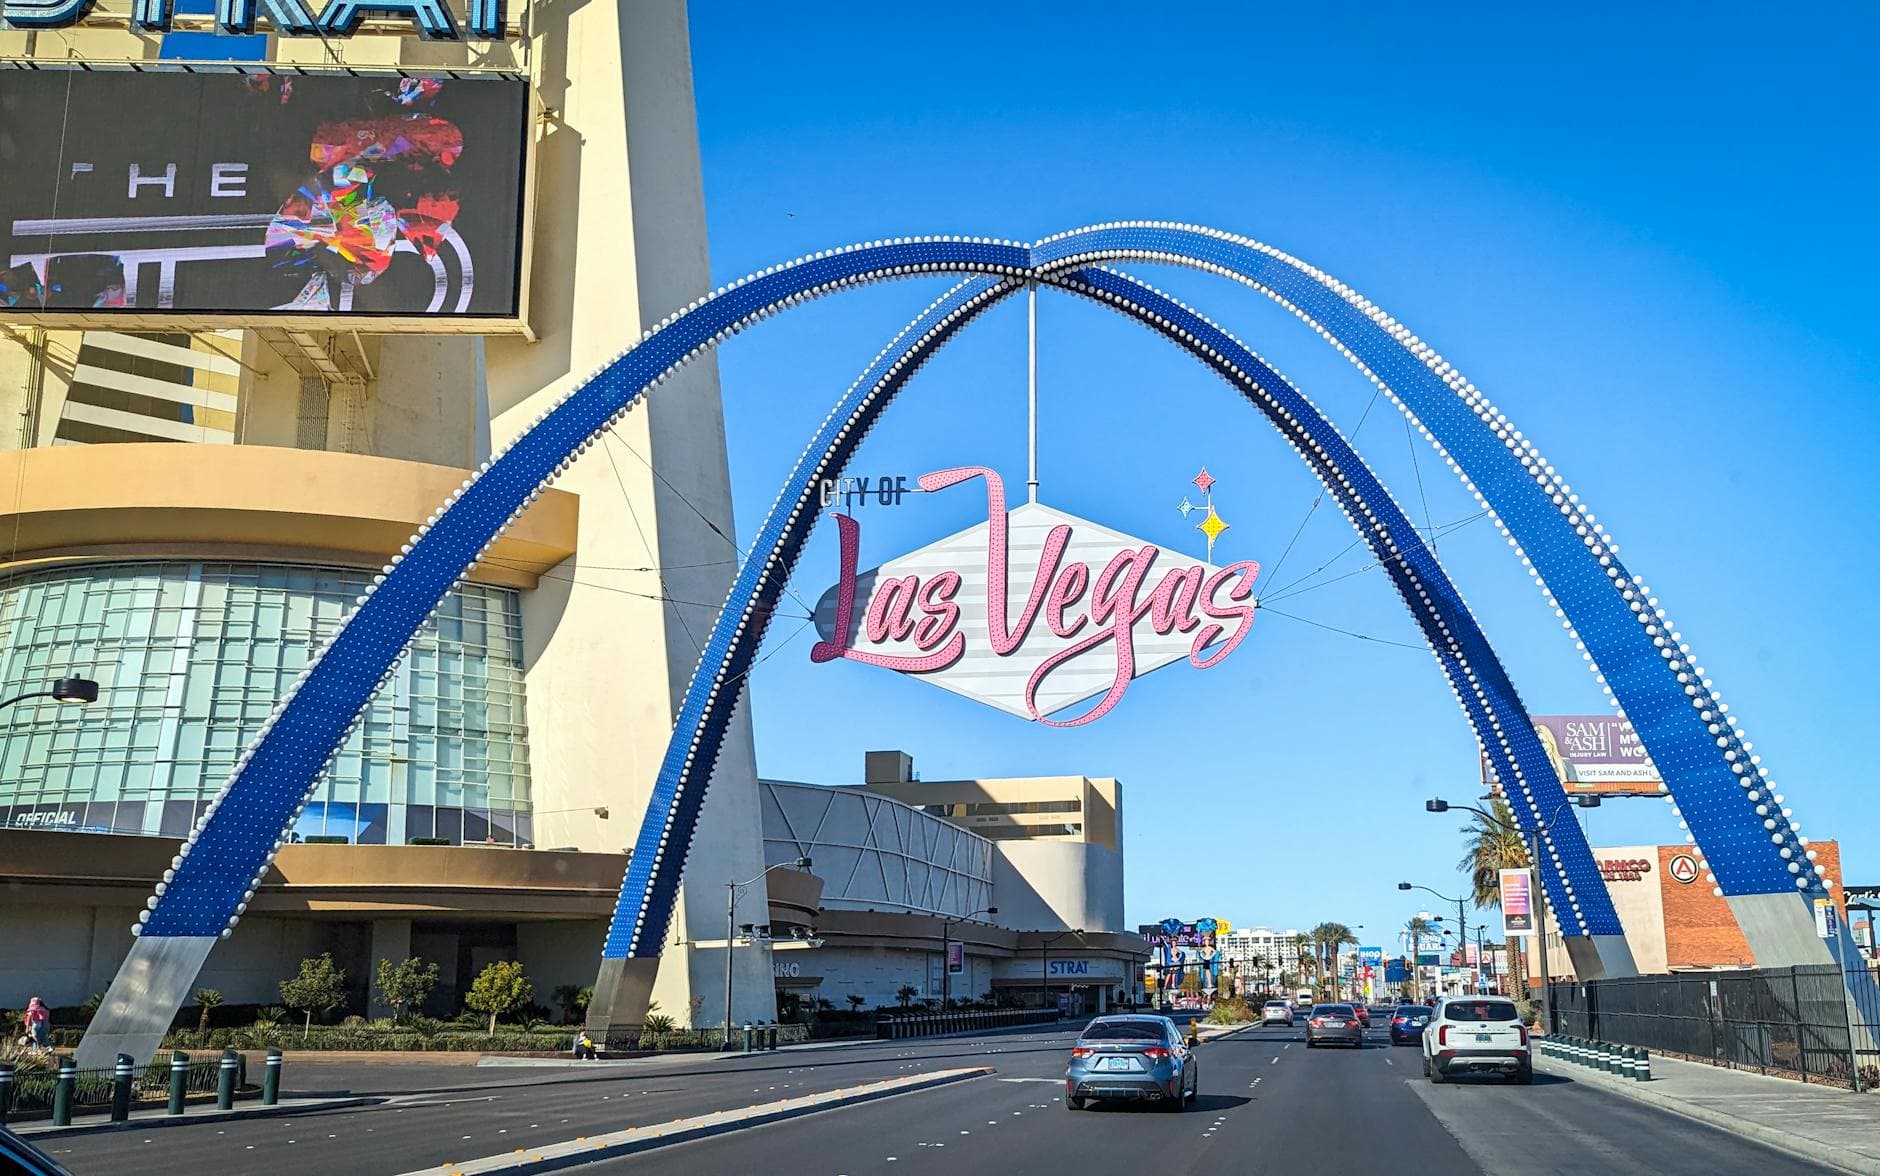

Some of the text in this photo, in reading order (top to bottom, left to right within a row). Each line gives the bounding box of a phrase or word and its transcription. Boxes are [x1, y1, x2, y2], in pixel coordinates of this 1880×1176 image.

[71, 162, 249, 199] HE
[820, 476, 907, 507] CITY OF
[810, 466, 1261, 728] Las Vegas
[1566, 722, 1605, 737] SAM
[1578, 769, 1596, 777] VISIT
[15, 811, 77, 827] OFFICIAL
[1050, 960, 1089, 974] STRAT
